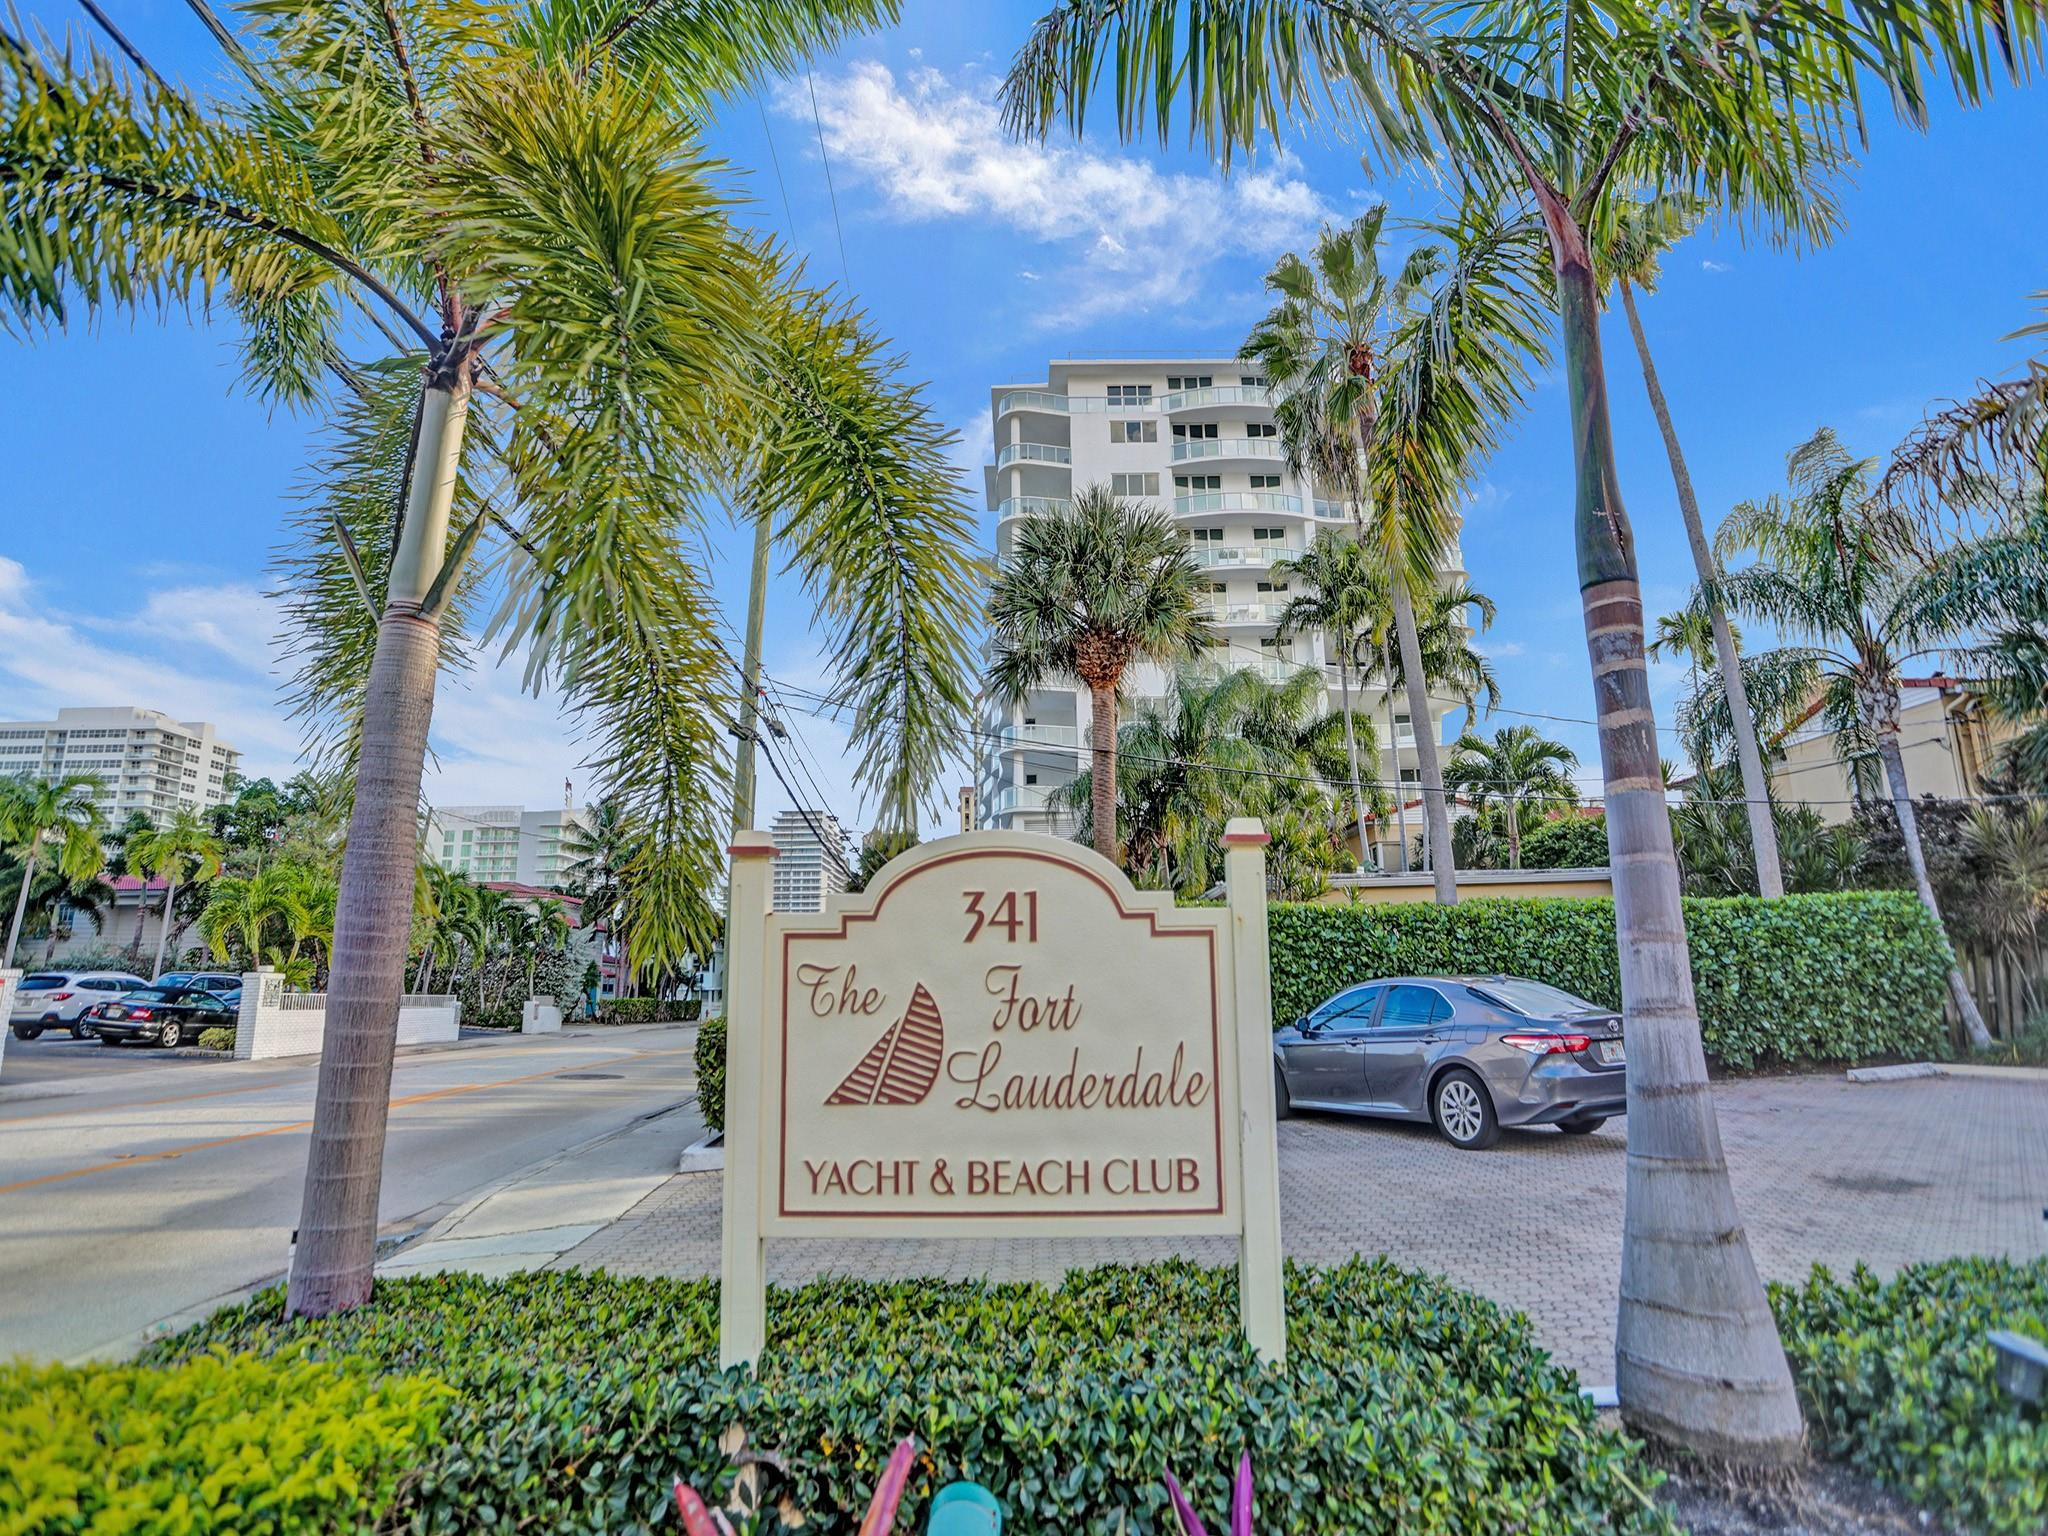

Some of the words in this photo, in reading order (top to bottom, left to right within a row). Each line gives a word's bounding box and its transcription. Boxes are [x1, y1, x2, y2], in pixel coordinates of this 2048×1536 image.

[964, 890, 1038, 944] 341
[796, 963, 887, 1017] The
[985, 964, 1083, 1033] Fort
[947, 1041, 1211, 1112] Lauderdale
[804, 1160, 920, 1196] YACHT
[930, 1159, 955, 1197] &
[968, 1159, 1091, 1197] BEACH
[1103, 1158, 1201, 1195] CLUB
